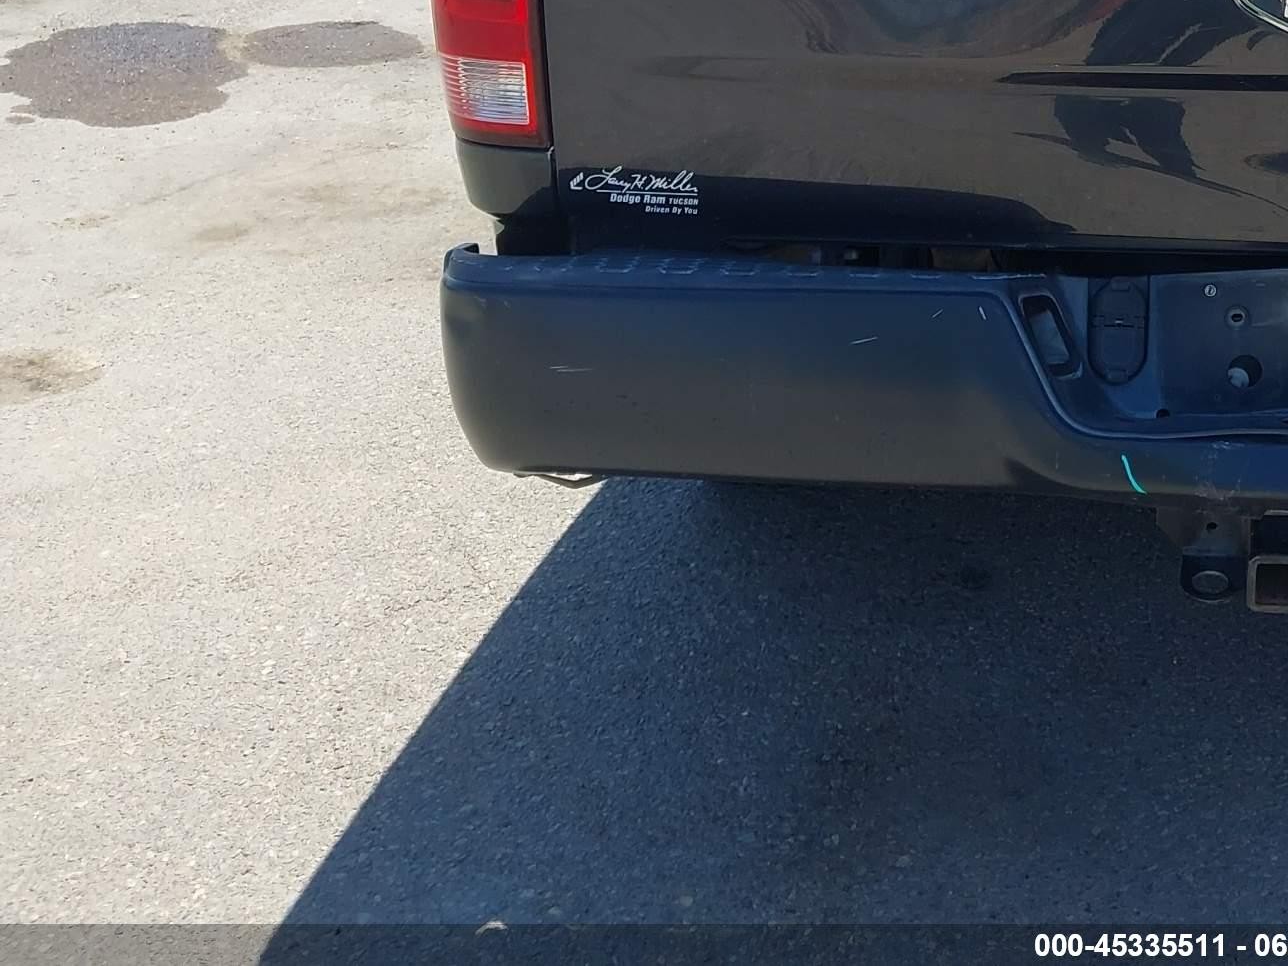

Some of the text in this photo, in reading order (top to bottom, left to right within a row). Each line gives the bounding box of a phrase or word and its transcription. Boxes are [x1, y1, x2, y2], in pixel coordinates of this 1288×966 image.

[609, 193, 699, 205] Dodge Ram TUCSON
[645, 205, 698, 214] Driven By You
